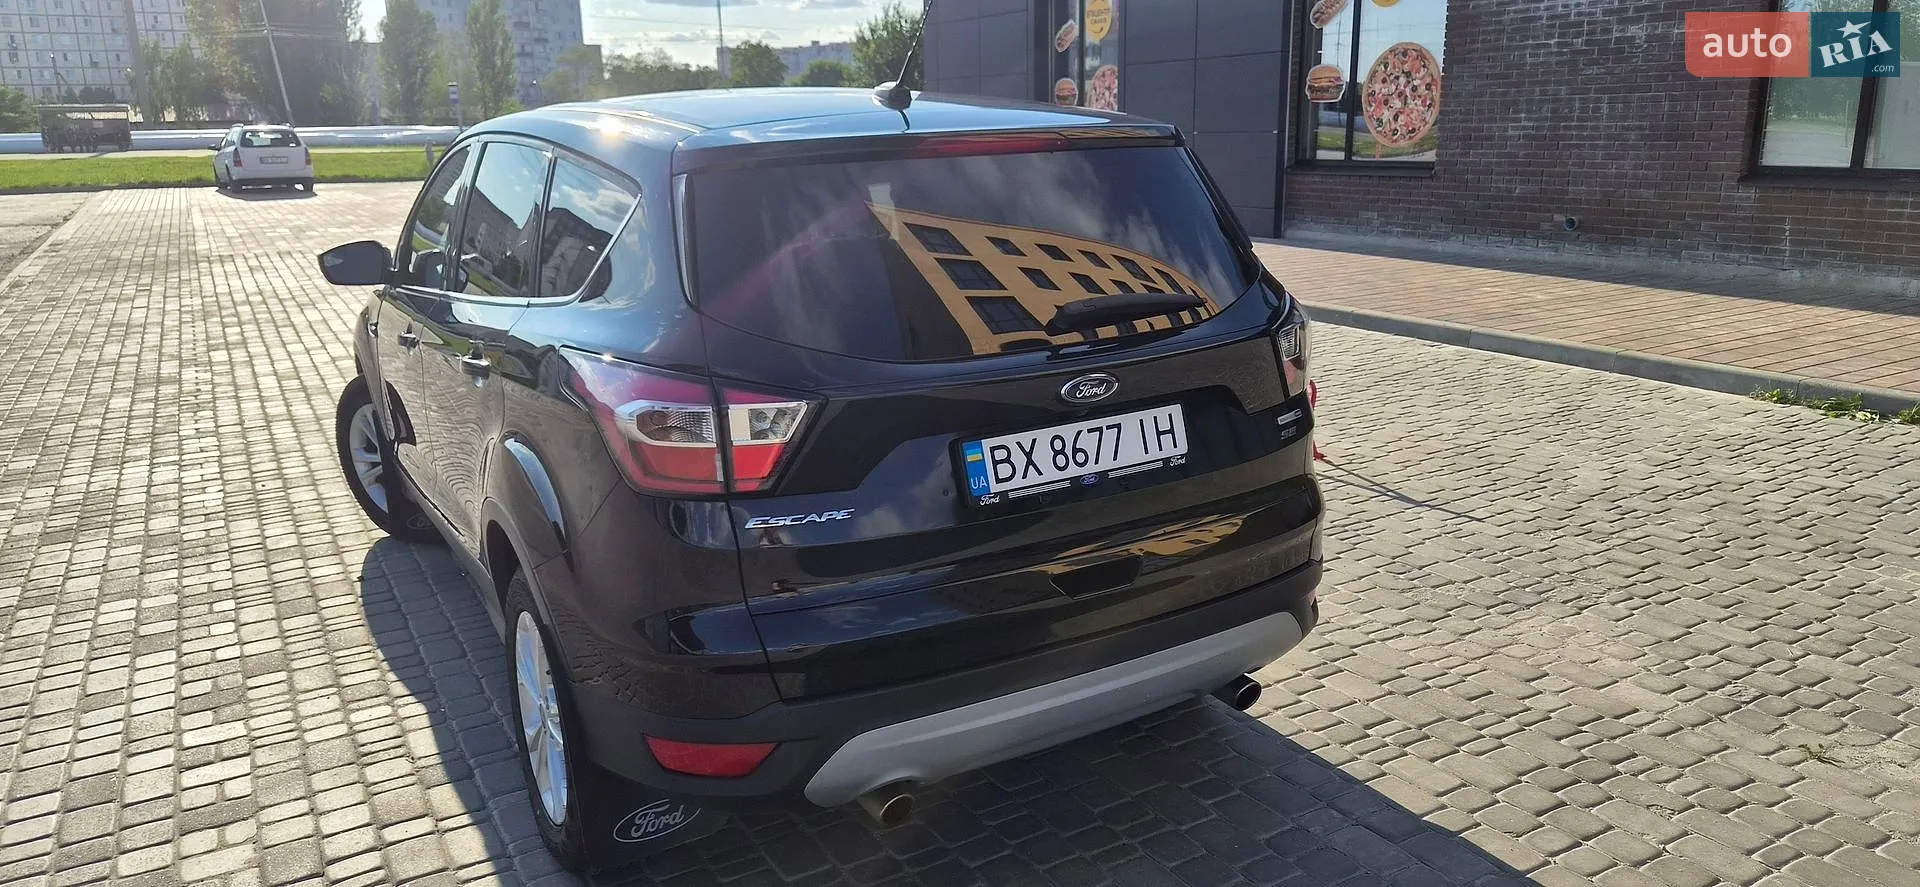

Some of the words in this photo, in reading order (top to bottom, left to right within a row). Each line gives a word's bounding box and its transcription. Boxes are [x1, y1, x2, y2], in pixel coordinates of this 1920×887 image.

[1076, 380, 1107, 398] Ford
[989, 438, 1043, 484] BX
[1049, 423, 1122, 472] 8677
[1139, 413, 1178, 455] IH
[970, 475, 988, 489] UA
[980, 493, 1000, 506] Ford
[1170, 455, 1186, 467] Ford
[745, 508, 855, 529] ESCAPE
[631, 804, 685, 838] Ford
